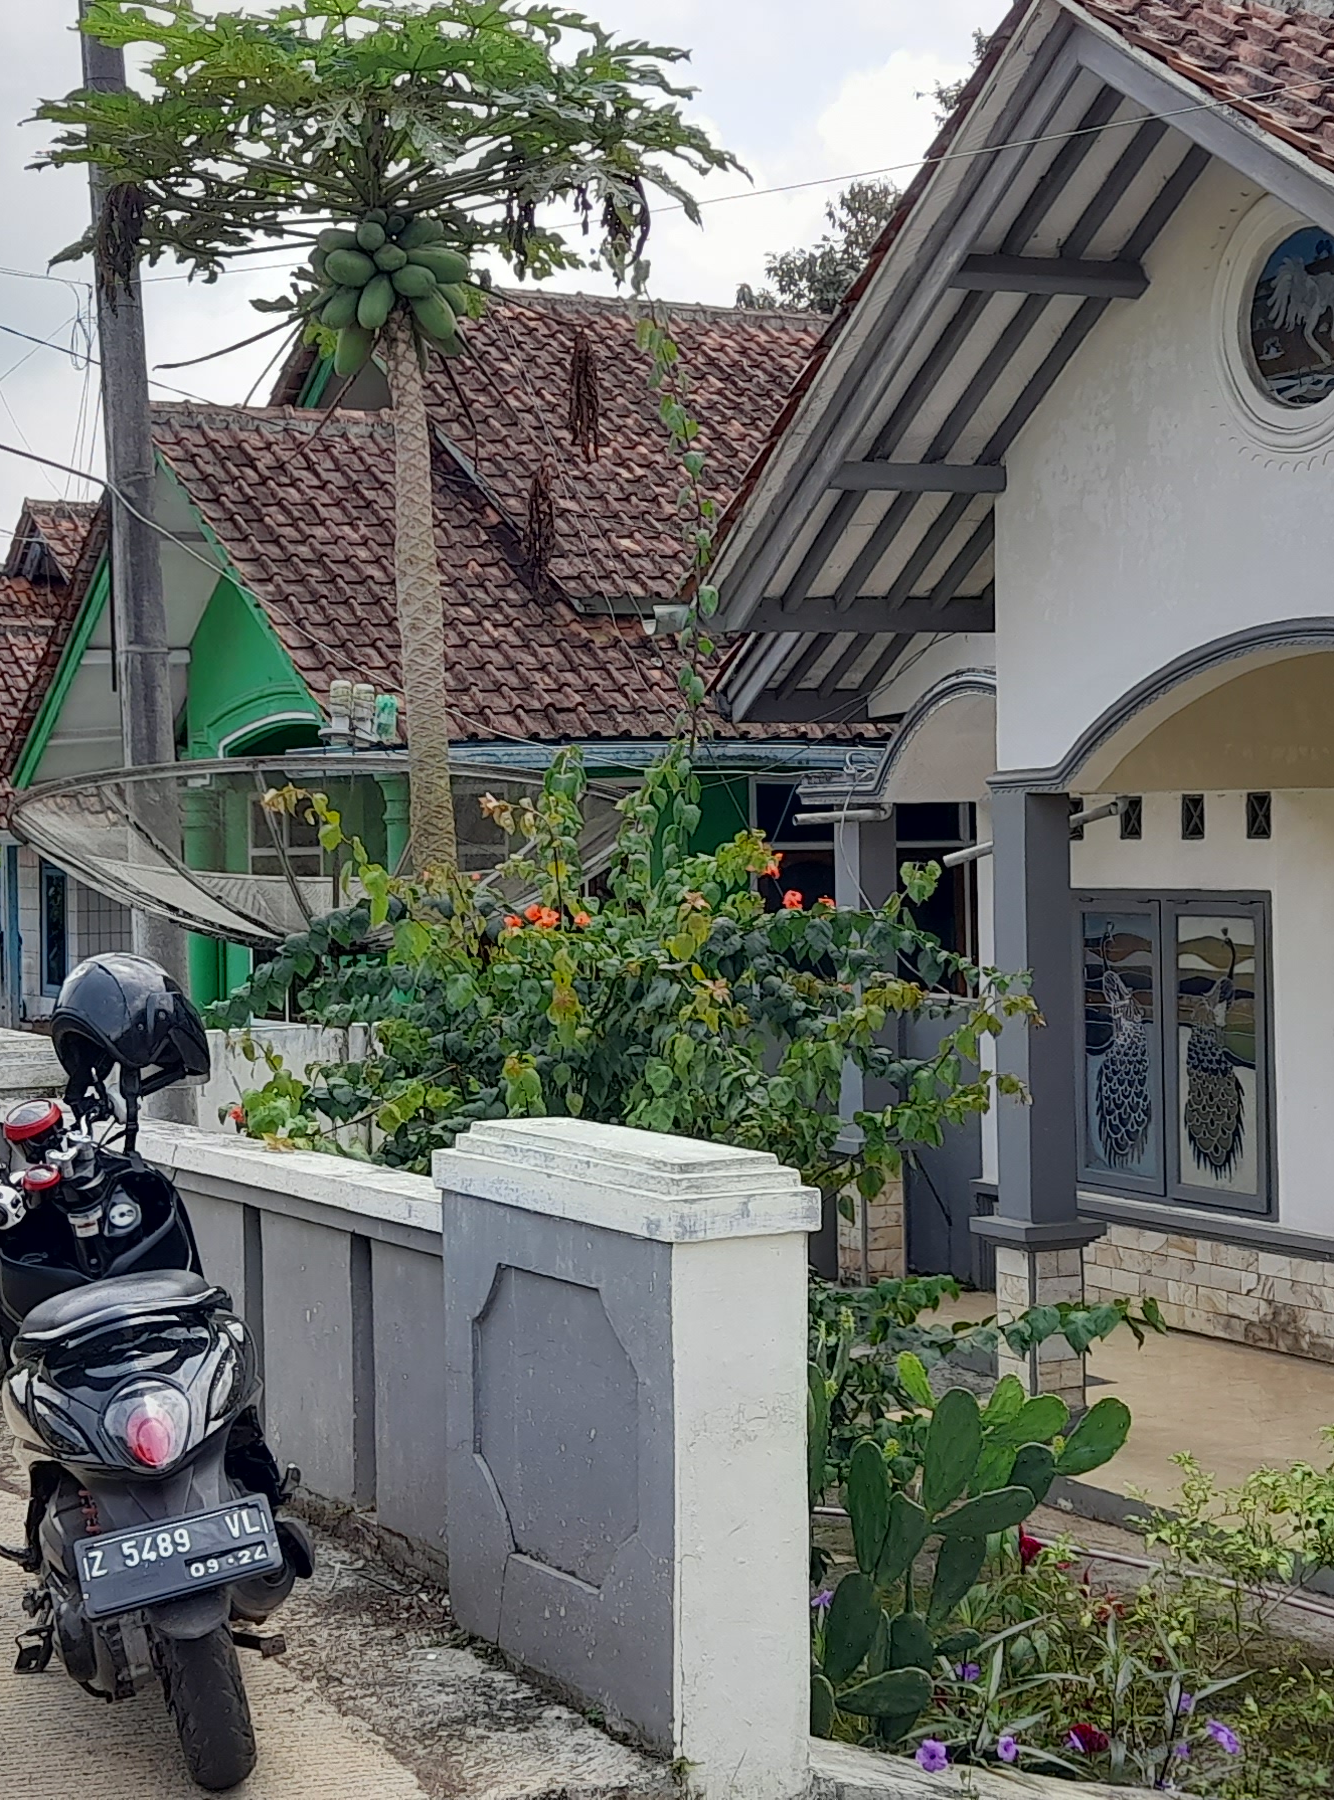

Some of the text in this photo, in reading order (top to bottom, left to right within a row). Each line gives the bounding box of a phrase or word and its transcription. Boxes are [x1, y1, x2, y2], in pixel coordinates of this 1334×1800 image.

[87, 1508, 261, 1578] Z 5489 VL
